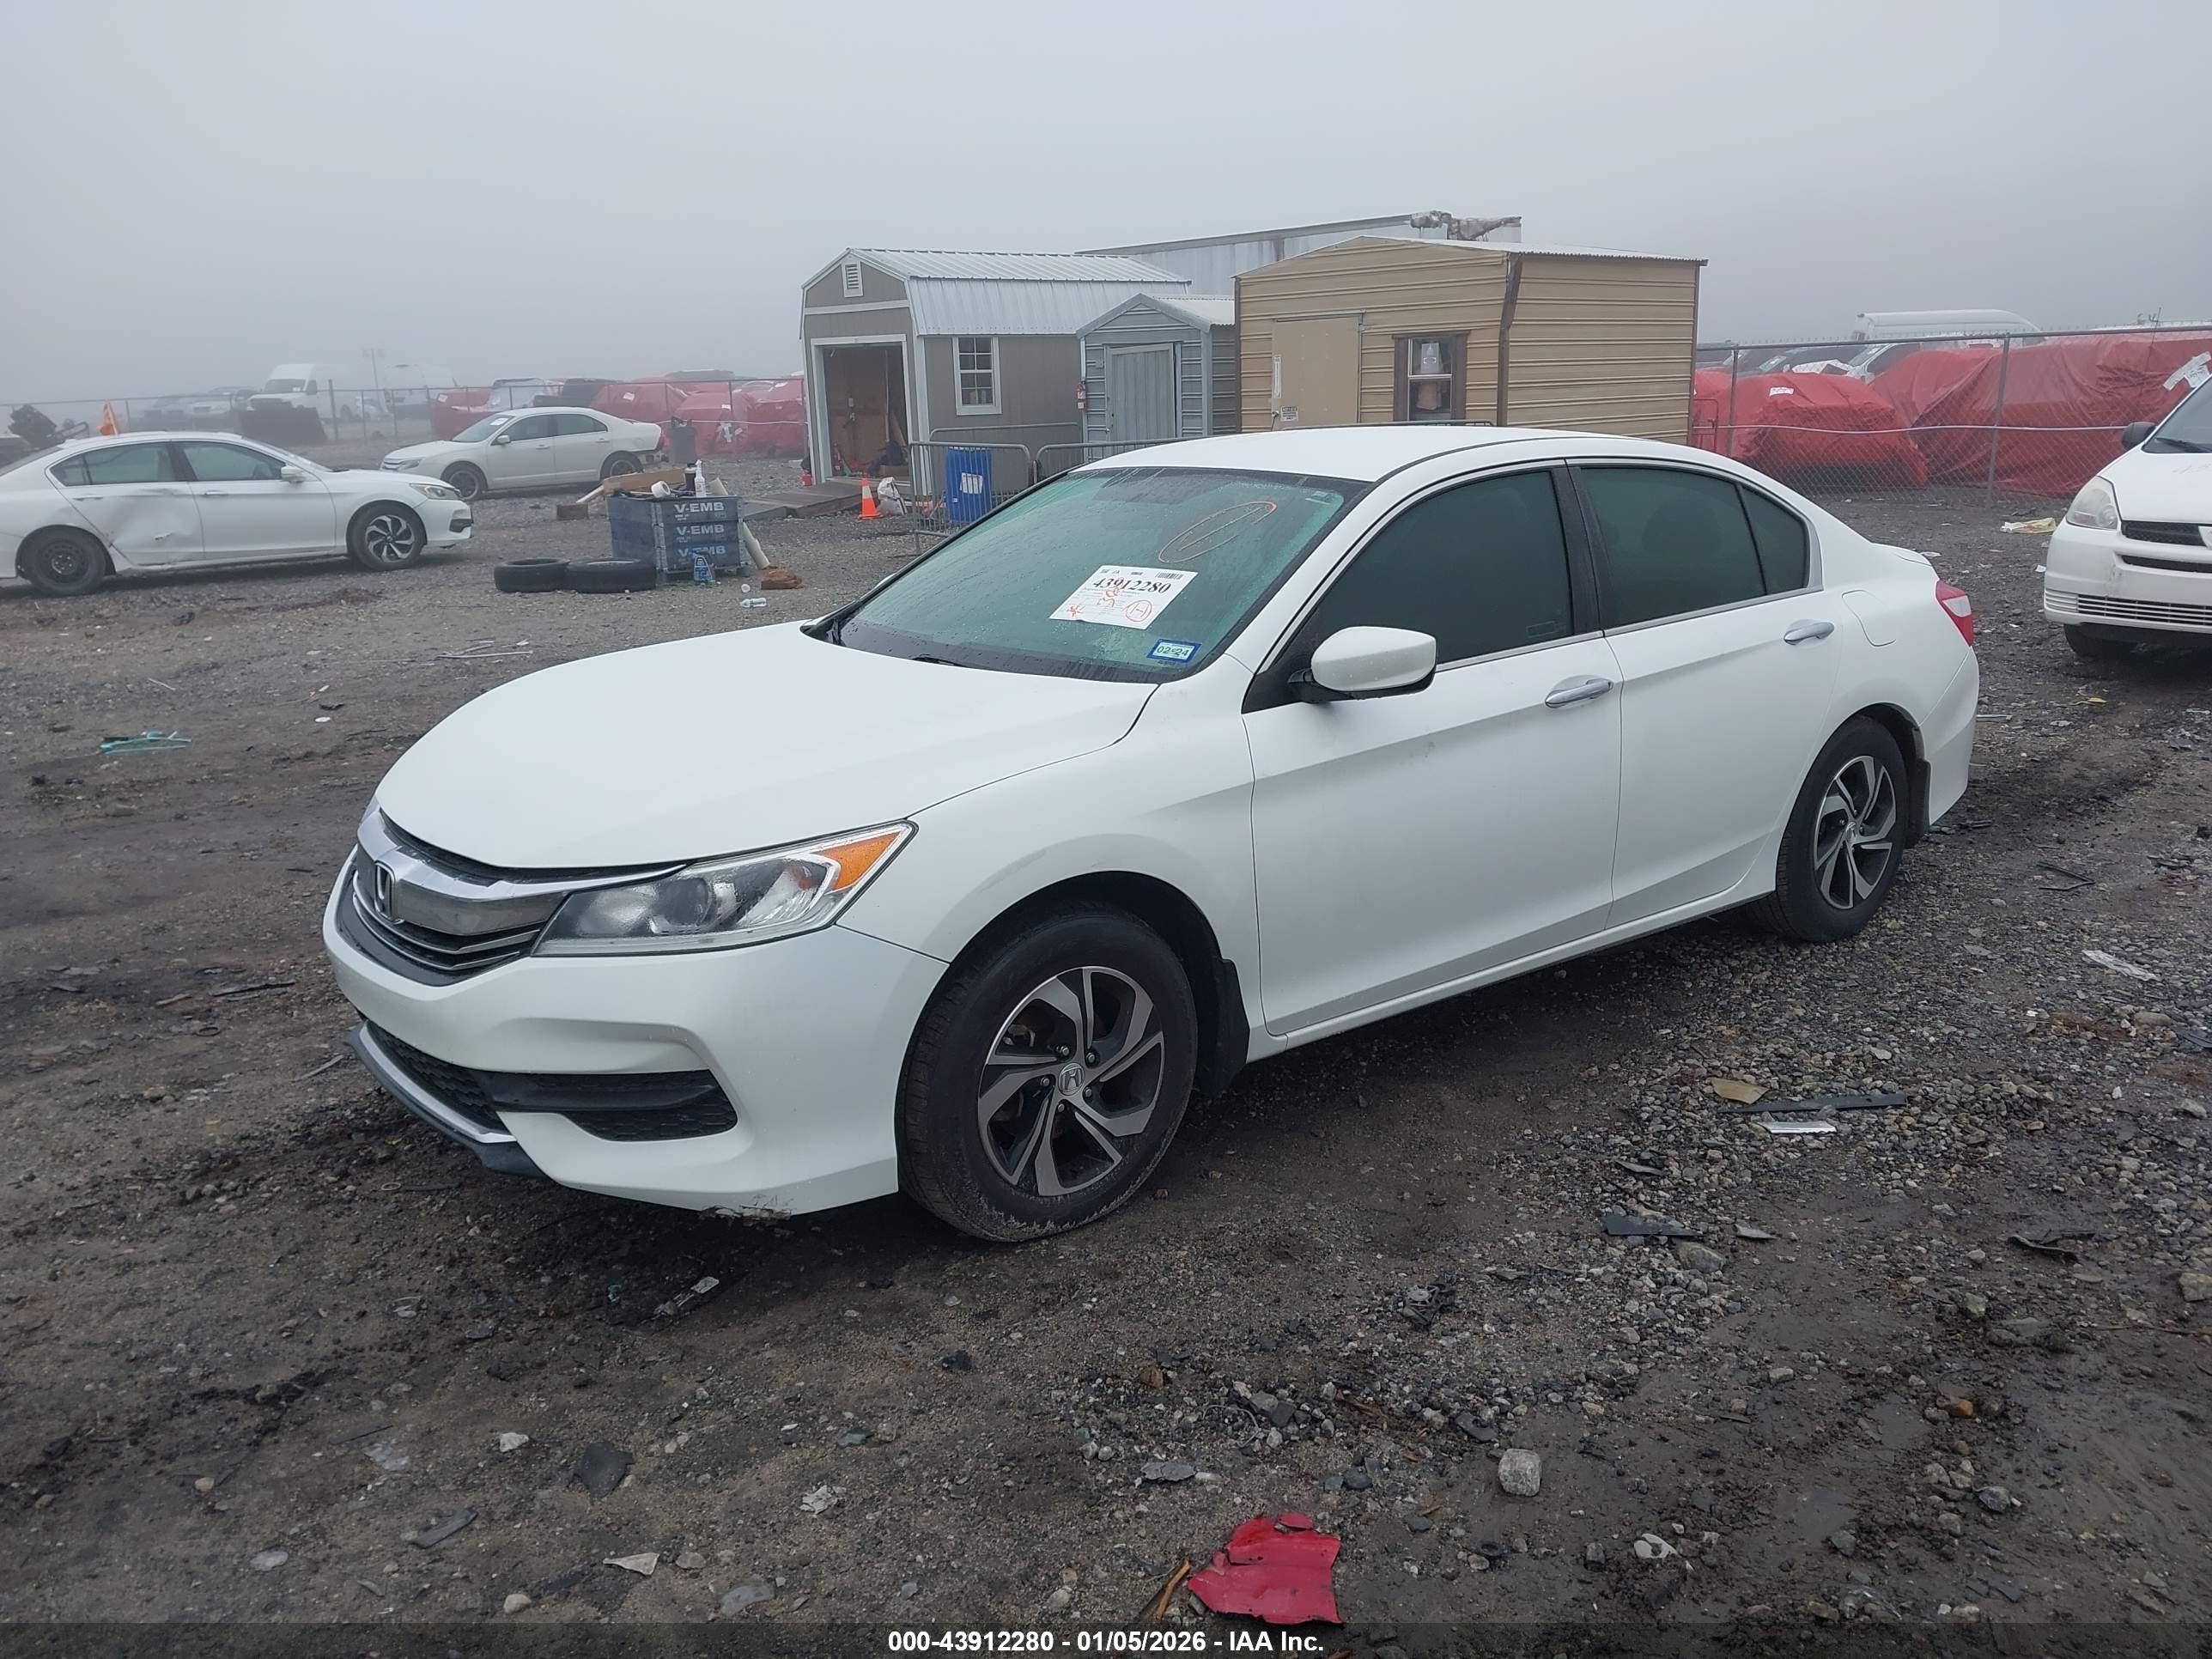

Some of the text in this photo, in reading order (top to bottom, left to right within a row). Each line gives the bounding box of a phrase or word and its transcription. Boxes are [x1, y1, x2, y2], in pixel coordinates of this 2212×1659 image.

[674, 501, 725, 514] V-EMB
[676, 524, 725, 536] V-EMB
[1092, 577, 1172, 594] 43912280
